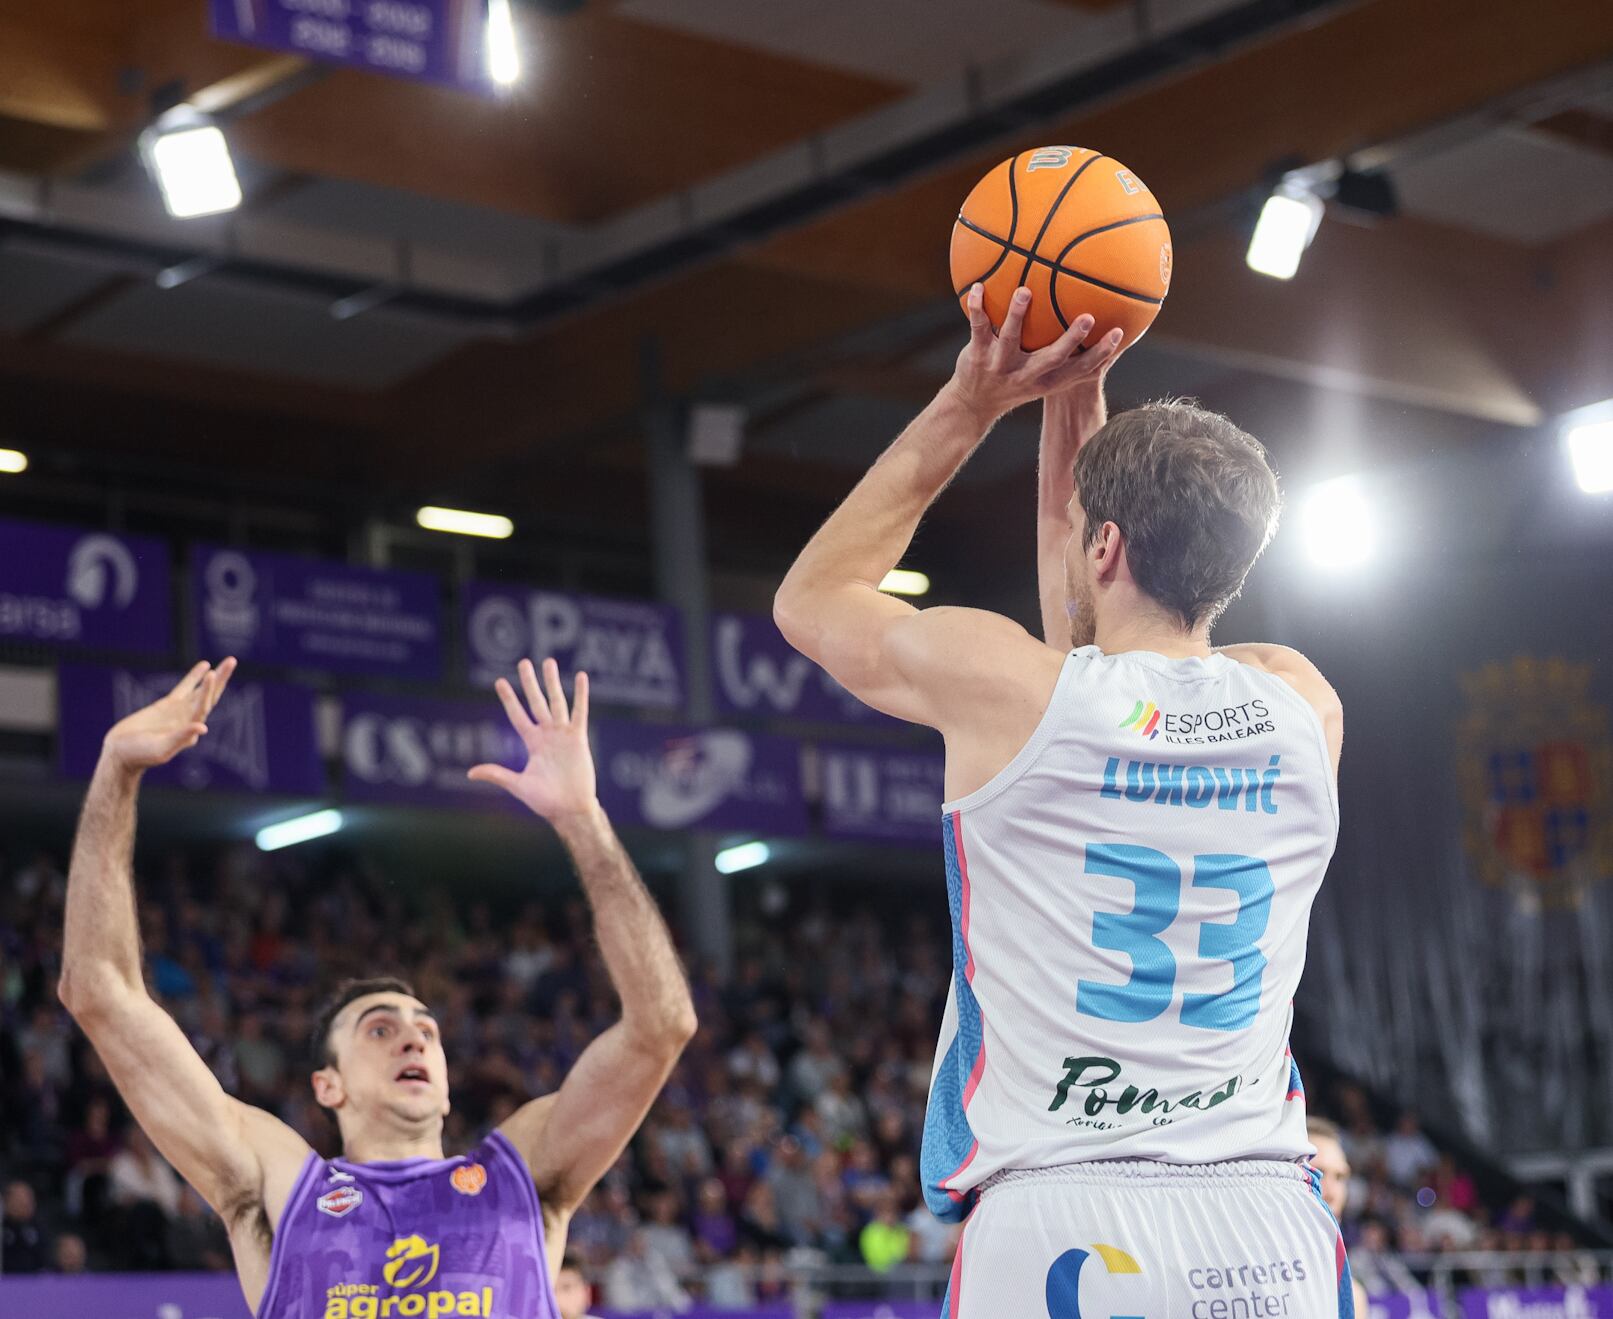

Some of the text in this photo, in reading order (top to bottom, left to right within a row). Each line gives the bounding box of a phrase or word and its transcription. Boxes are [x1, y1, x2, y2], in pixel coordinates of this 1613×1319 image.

[1165, 699, 1269, 734] ESPORTS
[1166, 720, 1275, 745] ILLES BALEARS
[1099, 754, 1281, 815] LUKOVIĆ
[1076, 843, 1275, 1031] 33
[1188, 1257, 1307, 1290] carreras
[323, 1287, 494, 1319] agropal
[326, 1282, 380, 1298] súper
[1191, 1291, 1291, 1319] center
